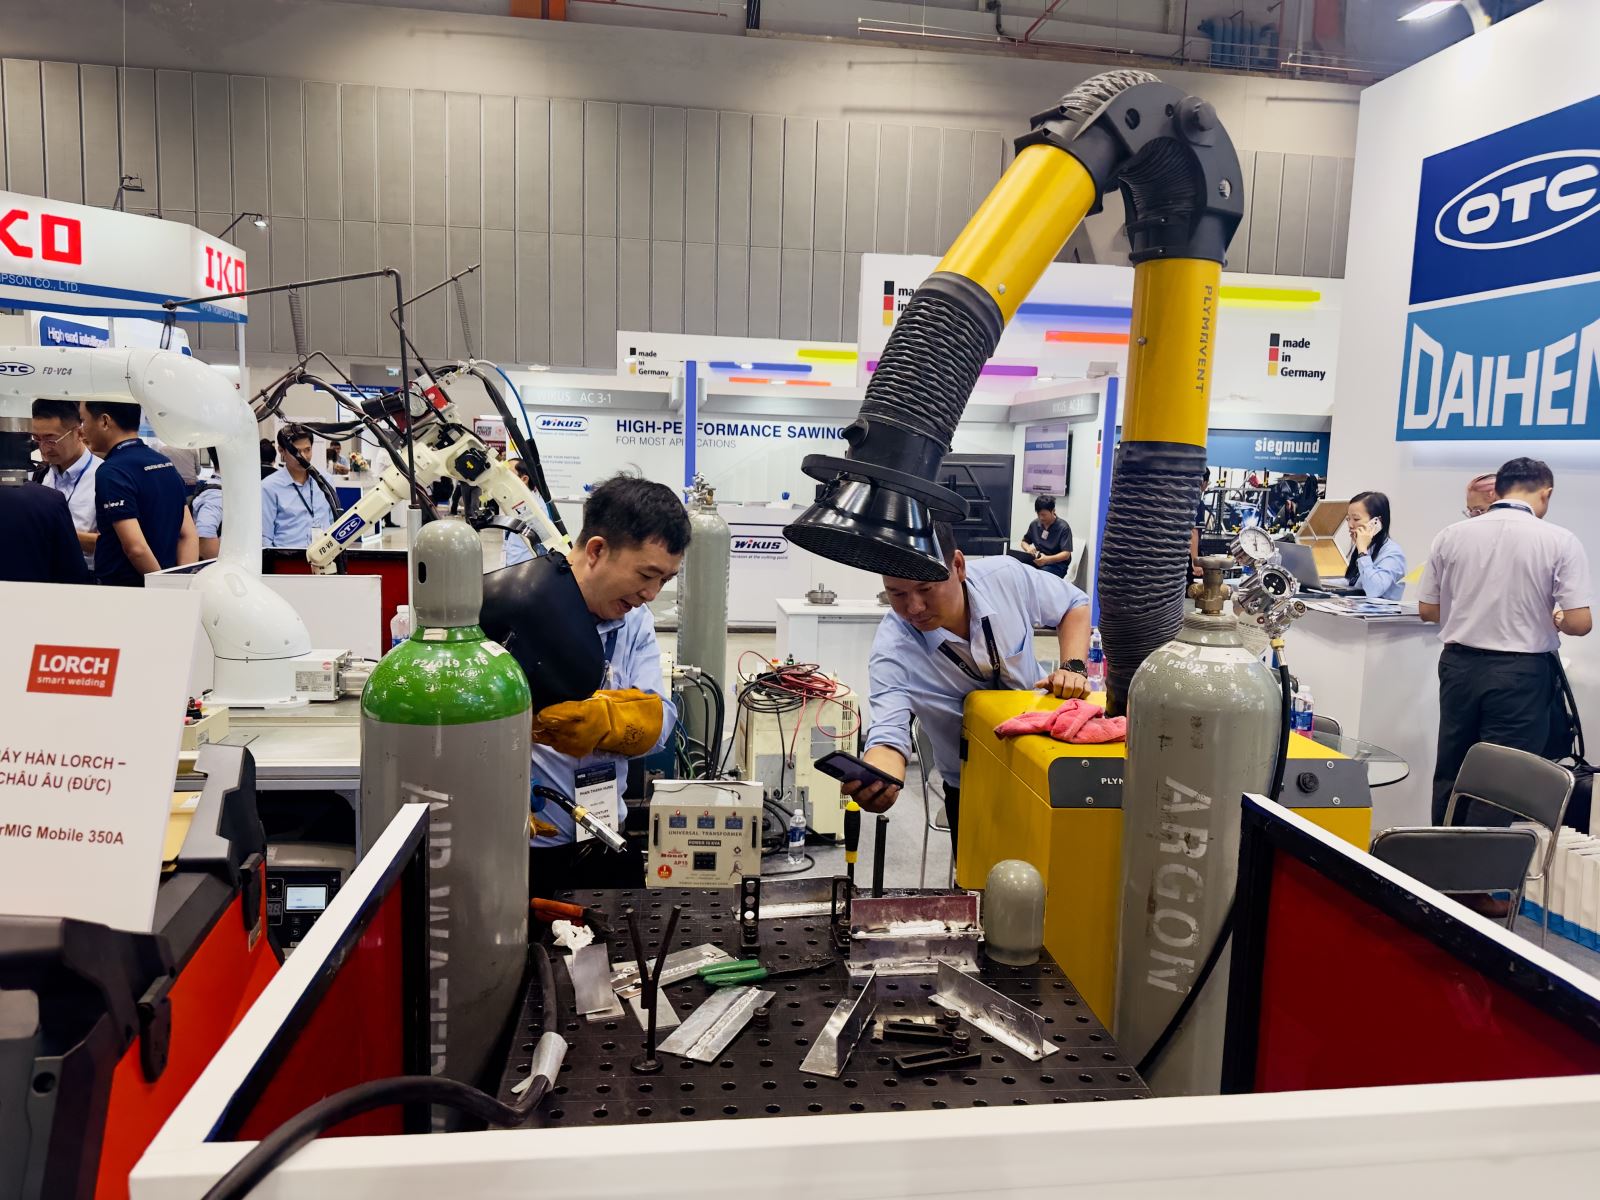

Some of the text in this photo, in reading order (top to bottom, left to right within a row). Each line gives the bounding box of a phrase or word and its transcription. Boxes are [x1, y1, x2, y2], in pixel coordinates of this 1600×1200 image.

[1457, 163, 1599, 235] OTC
[205, 245, 245, 300] IKO
[0, 273, 32, 287] PSON
[58, 280, 82, 292] LTD.
[47, 326, 65, 343] High
[64, 331, 79, 344] end
[1282, 337, 1311, 348] made
[638, 350, 657, 358] made
[1281, 352, 1291, 362] in
[638, 368, 670, 377] Germany
[1280, 366, 1326, 381] Germany
[580, 392, 594, 401] AC
[616, 419, 782, 438] HIGH-PEFORMANCE
[616, 435, 636, 445] FOR
[639, 436, 667, 446] MOST
[1254, 437, 1320, 456] siegmund
[338, 520, 358, 538] OTC
[39, 654, 110, 675] LORCH
[37, 675, 106, 688] smart welding
[0, 747, 21, 763] ÁY
[61, 753, 114, 770] LORCH
[42, 772, 63, 789] ÂU
[67, 774, 112, 795] (ĐỨC)
[36, 825, 84, 842] Mobile
[88, 829, 124, 845] 350A
[1147, 776, 1212, 994] ARGON
